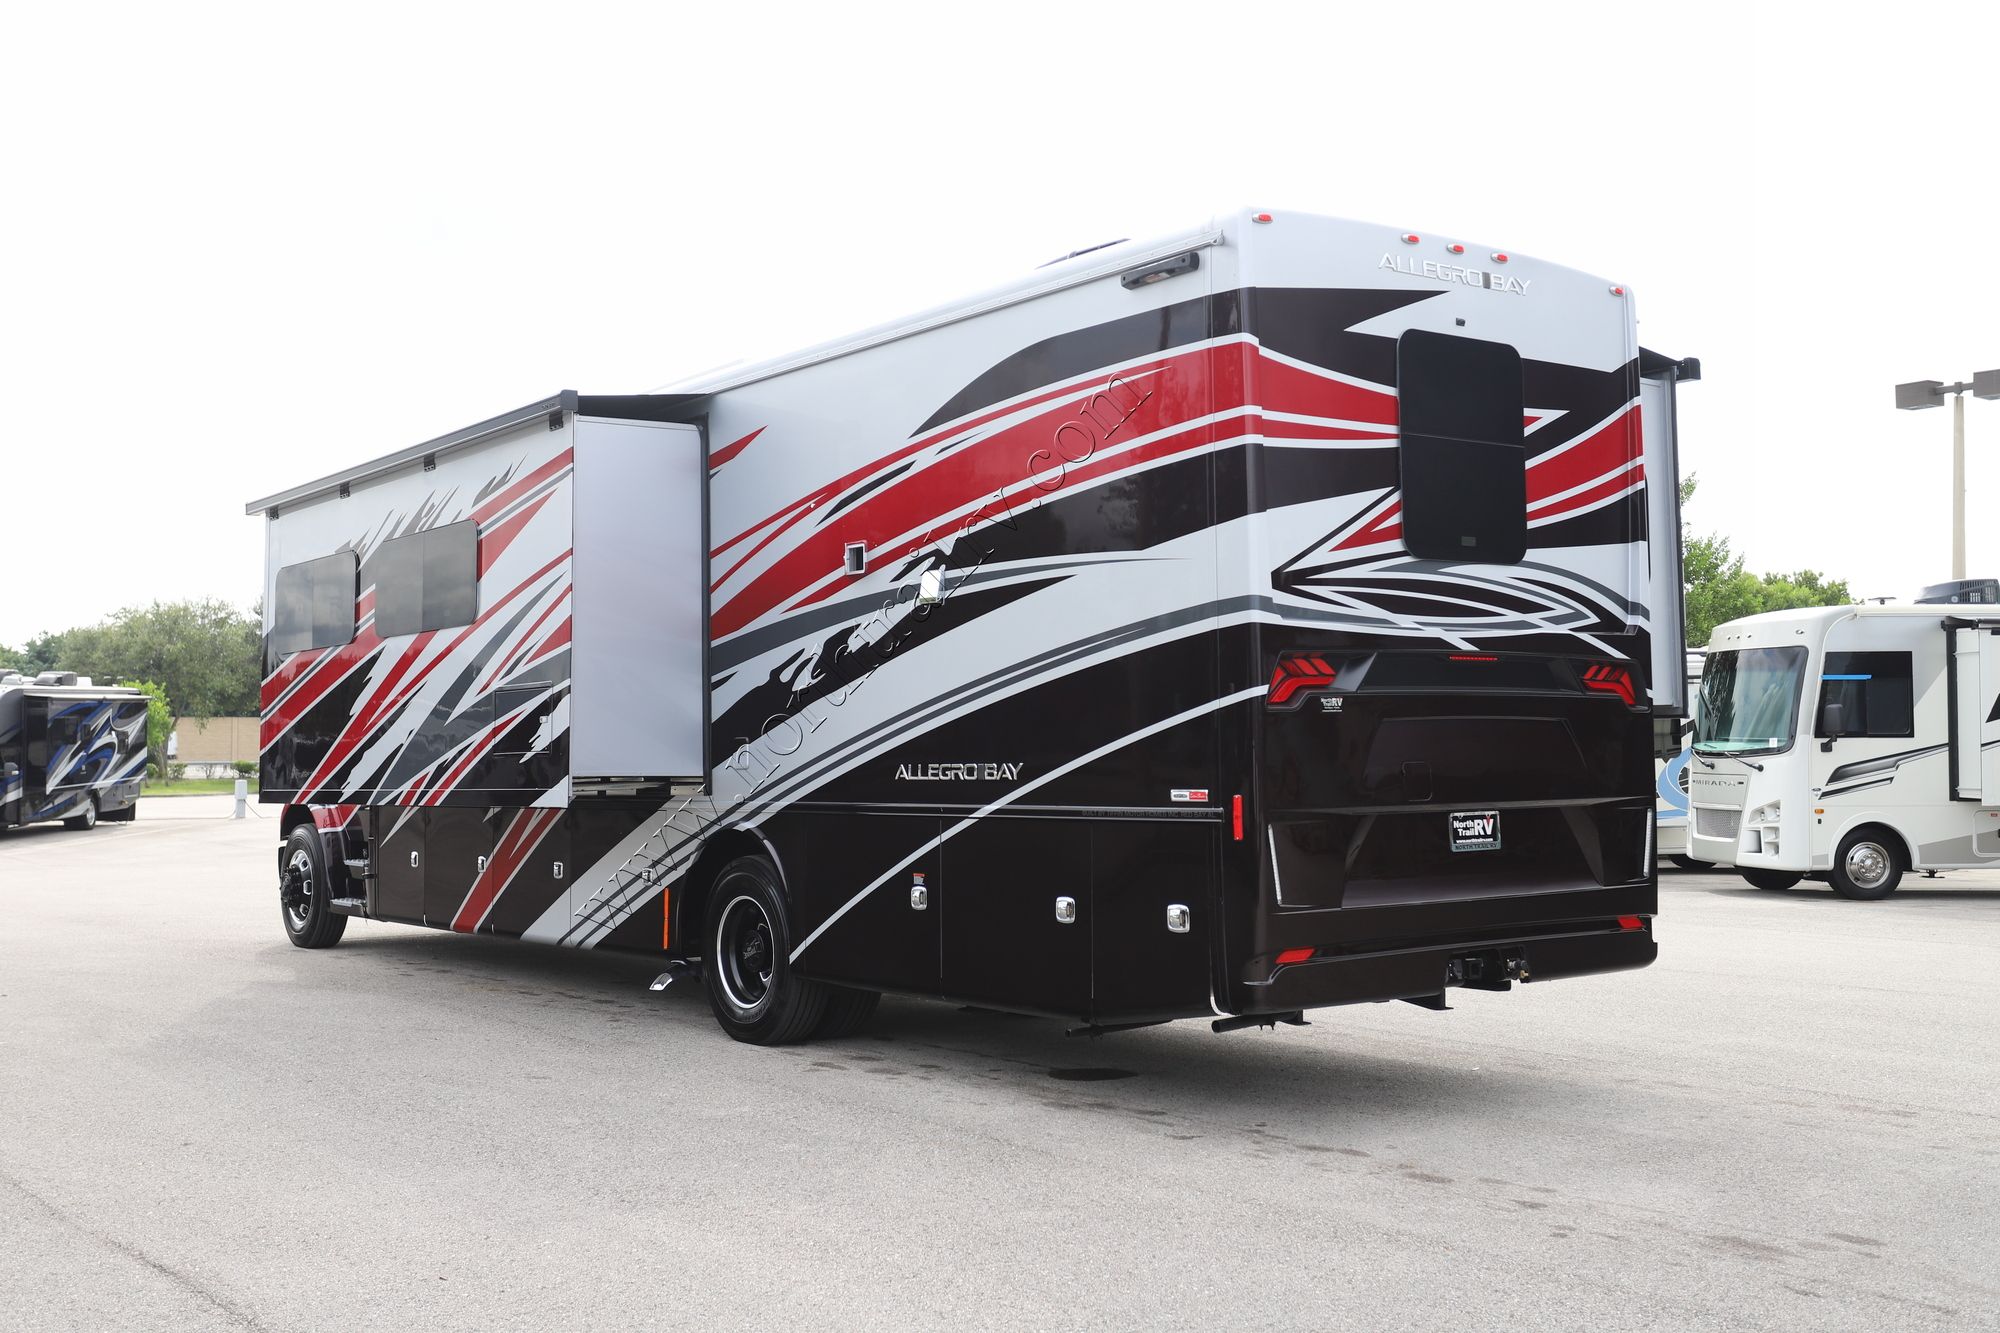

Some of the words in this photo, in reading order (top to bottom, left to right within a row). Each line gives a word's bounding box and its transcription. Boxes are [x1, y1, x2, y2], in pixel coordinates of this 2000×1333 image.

[1378, 252, 1482, 288] ALLEGRO
[1491, 274, 1531, 296] BAY
[895, 763, 978, 780] ALLEGRO
[984, 762, 1024, 780] BAY
[1453, 820, 1474, 829] North
[1457, 828, 1474, 836] Trail
[1474, 819, 1494, 836] RV
